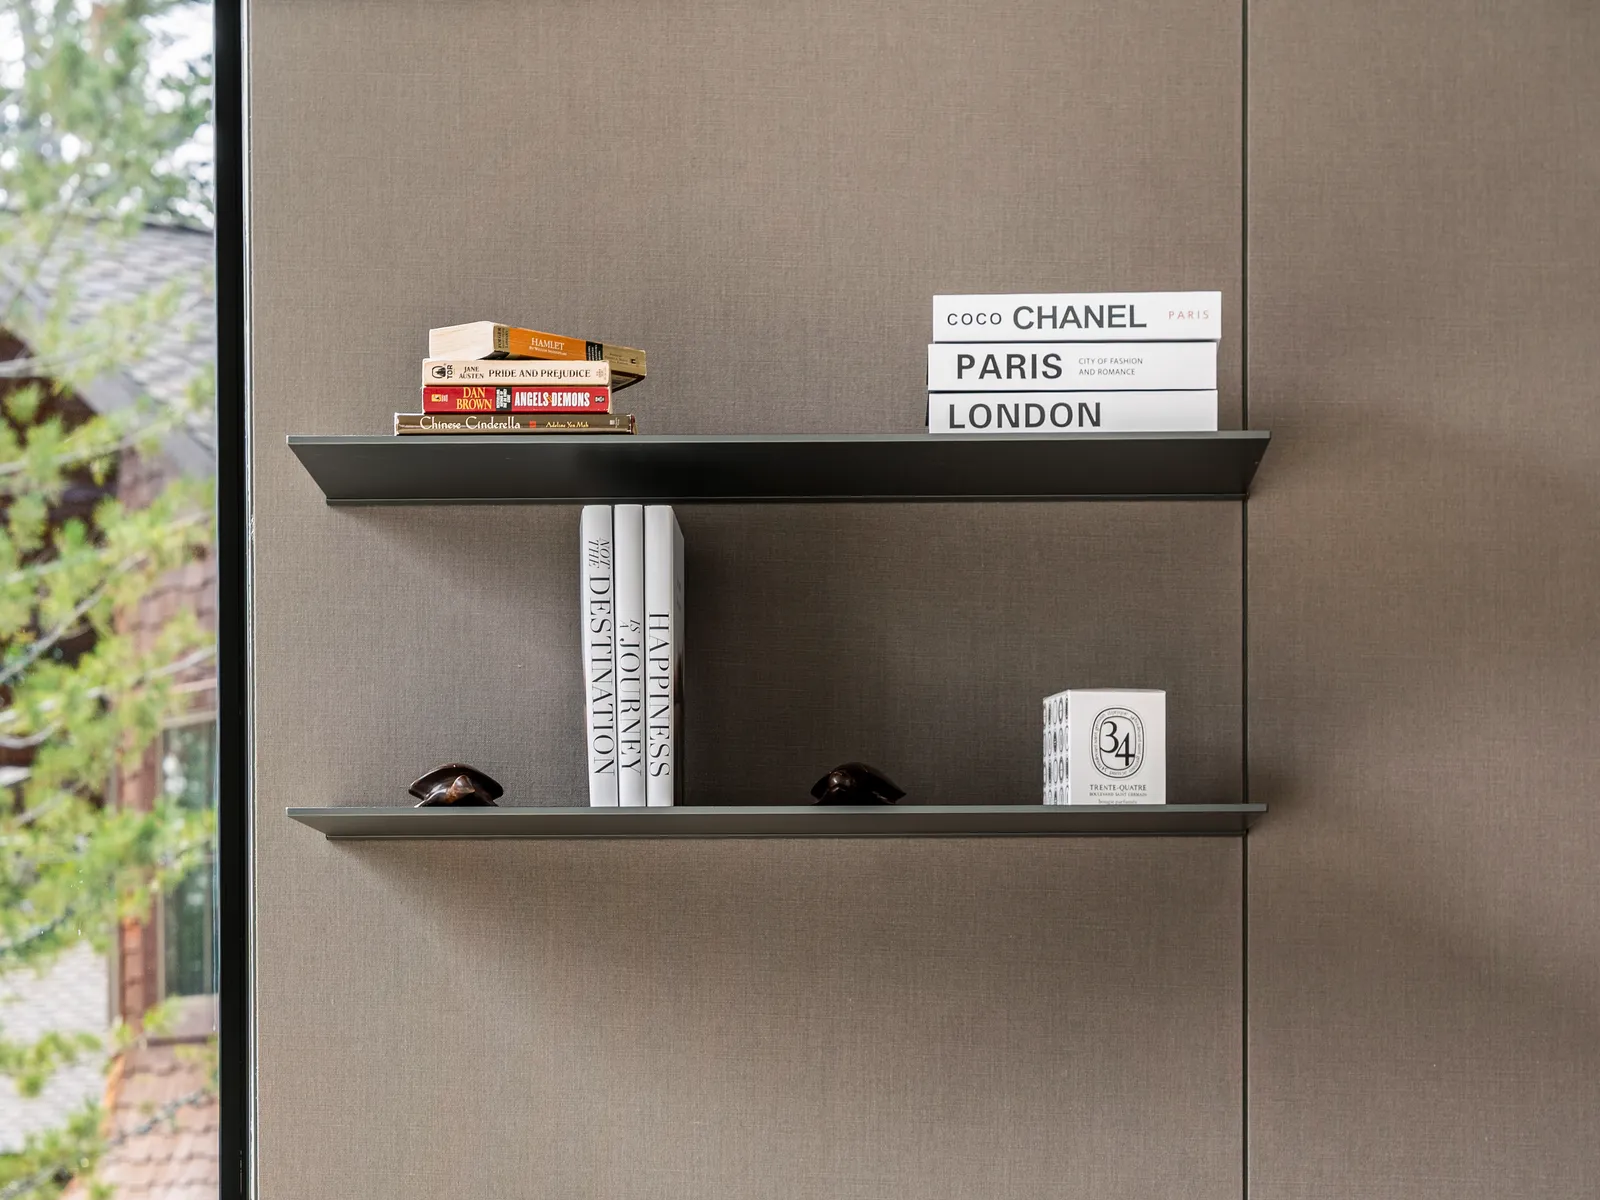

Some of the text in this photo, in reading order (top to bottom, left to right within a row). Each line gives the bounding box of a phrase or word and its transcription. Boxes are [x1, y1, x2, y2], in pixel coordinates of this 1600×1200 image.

[947, 304, 1210, 330] COCO CHANEL PARIS
[531, 337, 565, 351] HAMLET
[957, 353, 1063, 380] PARIS
[1078, 357, 1143, 365] CITY OF FASHION
[488, 369, 517, 378] PRIDE
[519, 369, 539, 378] AND
[540, 369, 591, 379] PREJUDICE
[1079, 368, 1136, 376] AND ROMANCE
[463, 387, 486, 398] DAN
[514, 391, 549, 407] ANGELS
[551, 391, 591, 407] DEMONS
[456, 398, 493, 410] BROWN
[420, 415, 521, 430] Chinese Cinderella
[949, 402, 1101, 429] LONDON
[588, 539, 600, 569] THE
[600, 537, 611, 569] NOT
[630, 619, 641, 633] IS
[589, 574, 615, 775] DESTINATION
[649, 611, 670, 777] HAPPINESS
[619, 638, 642, 776] JOURNEY
[1100, 720, 1136, 767] 34
[1089, 784, 1147, 792] TRENTE-QUATRE
